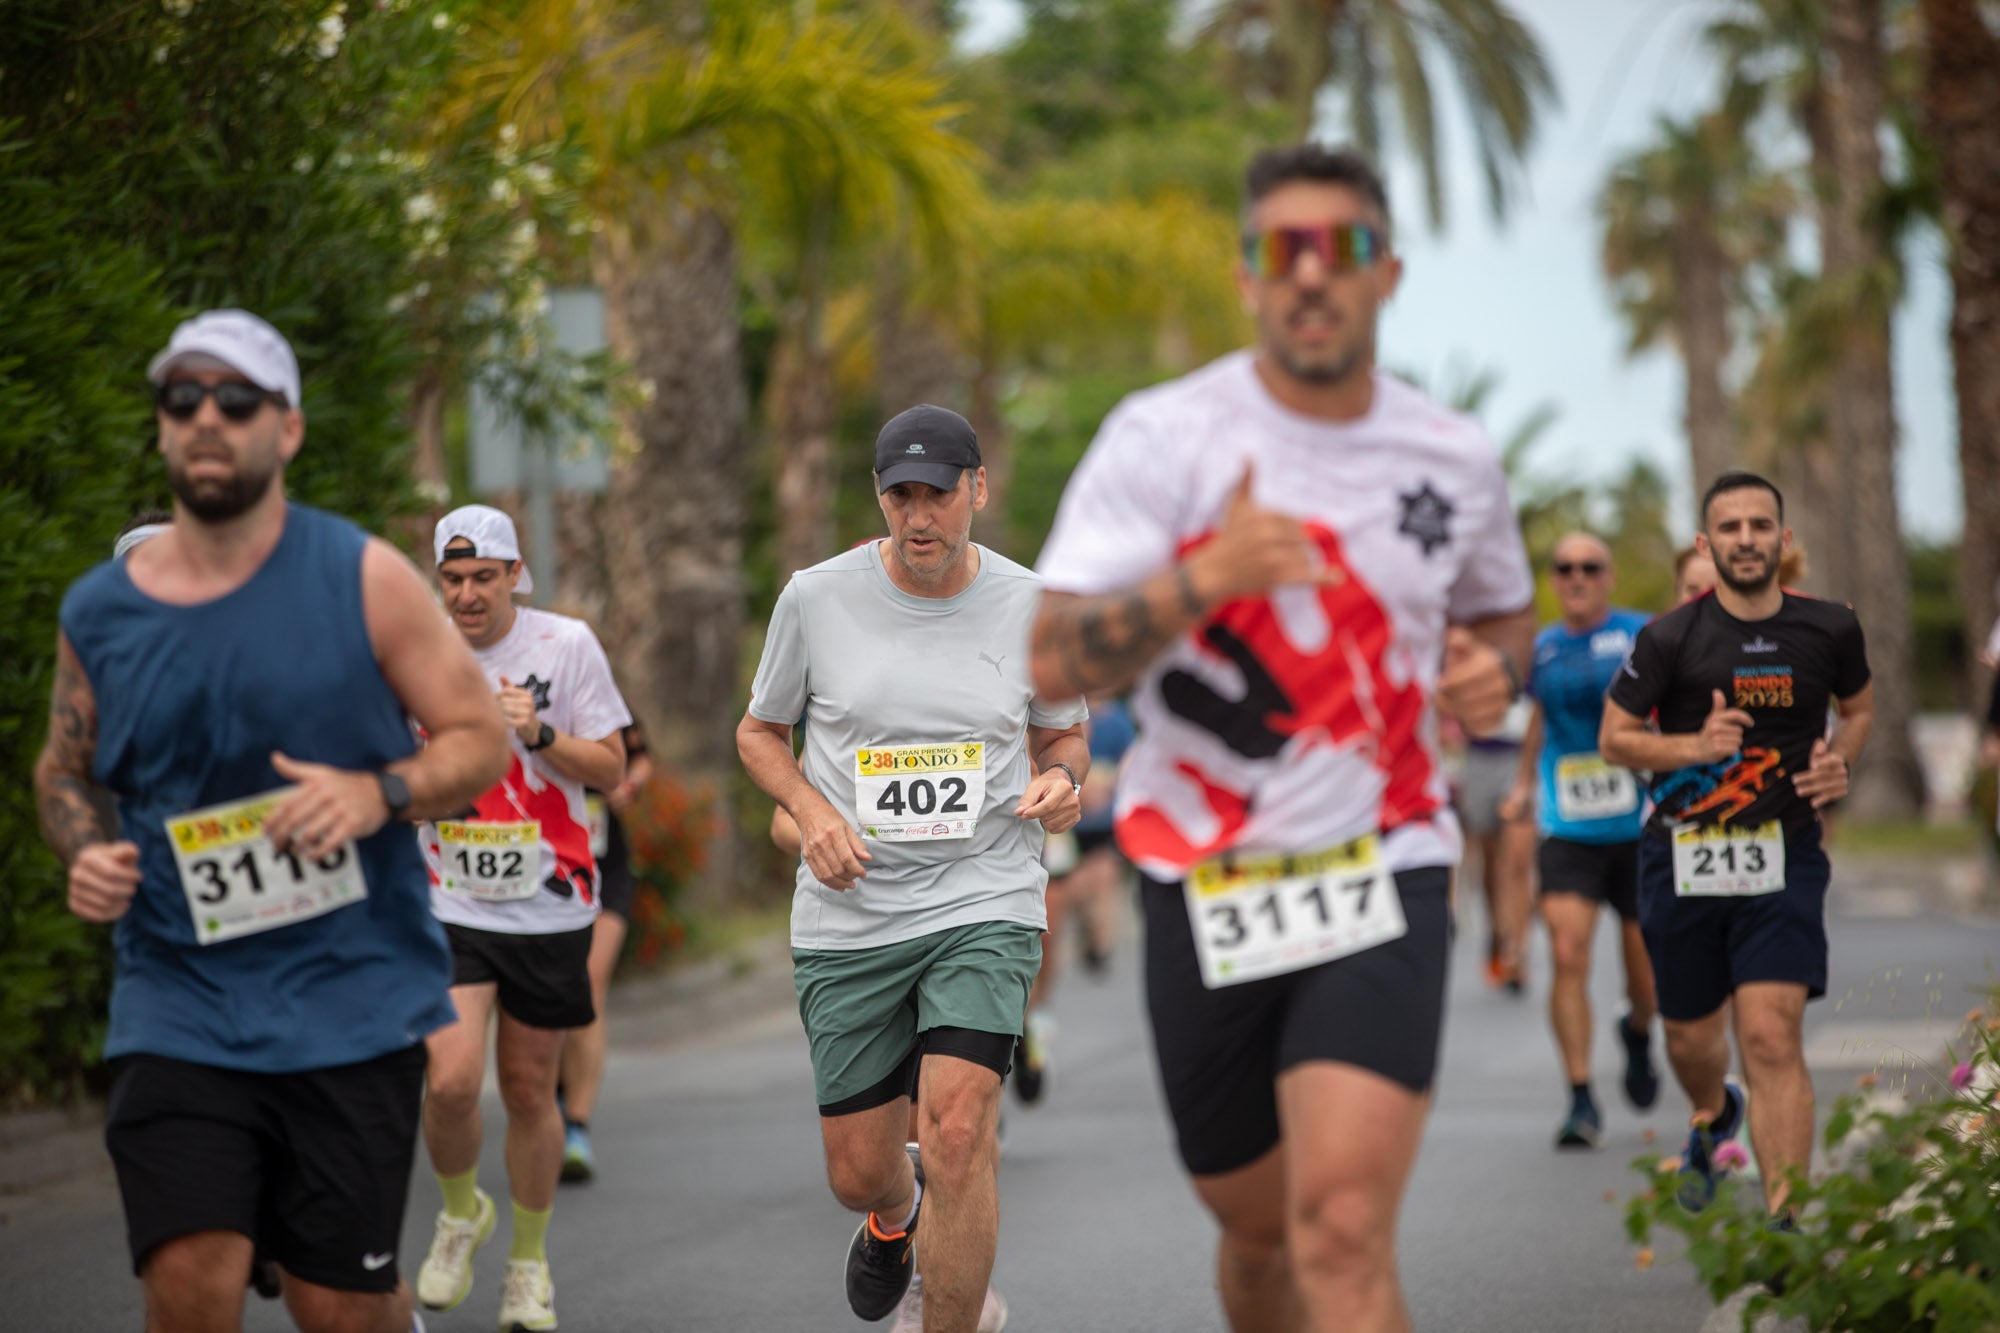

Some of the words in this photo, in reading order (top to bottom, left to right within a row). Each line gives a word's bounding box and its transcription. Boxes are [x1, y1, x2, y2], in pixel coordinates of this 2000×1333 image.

[1733, 674, 1793, 691] FONDO
[1735, 689, 1794, 708] 2025
[873, 752, 893, 769] 38
[893, 753, 958, 769] FONDO
[921, 747, 951, 755] PREMIO
[876, 777, 968, 816] 402
[455, 849, 524, 879] 182
[1693, 845, 1767, 876] 213
[1207, 877, 1376, 950] 3117
